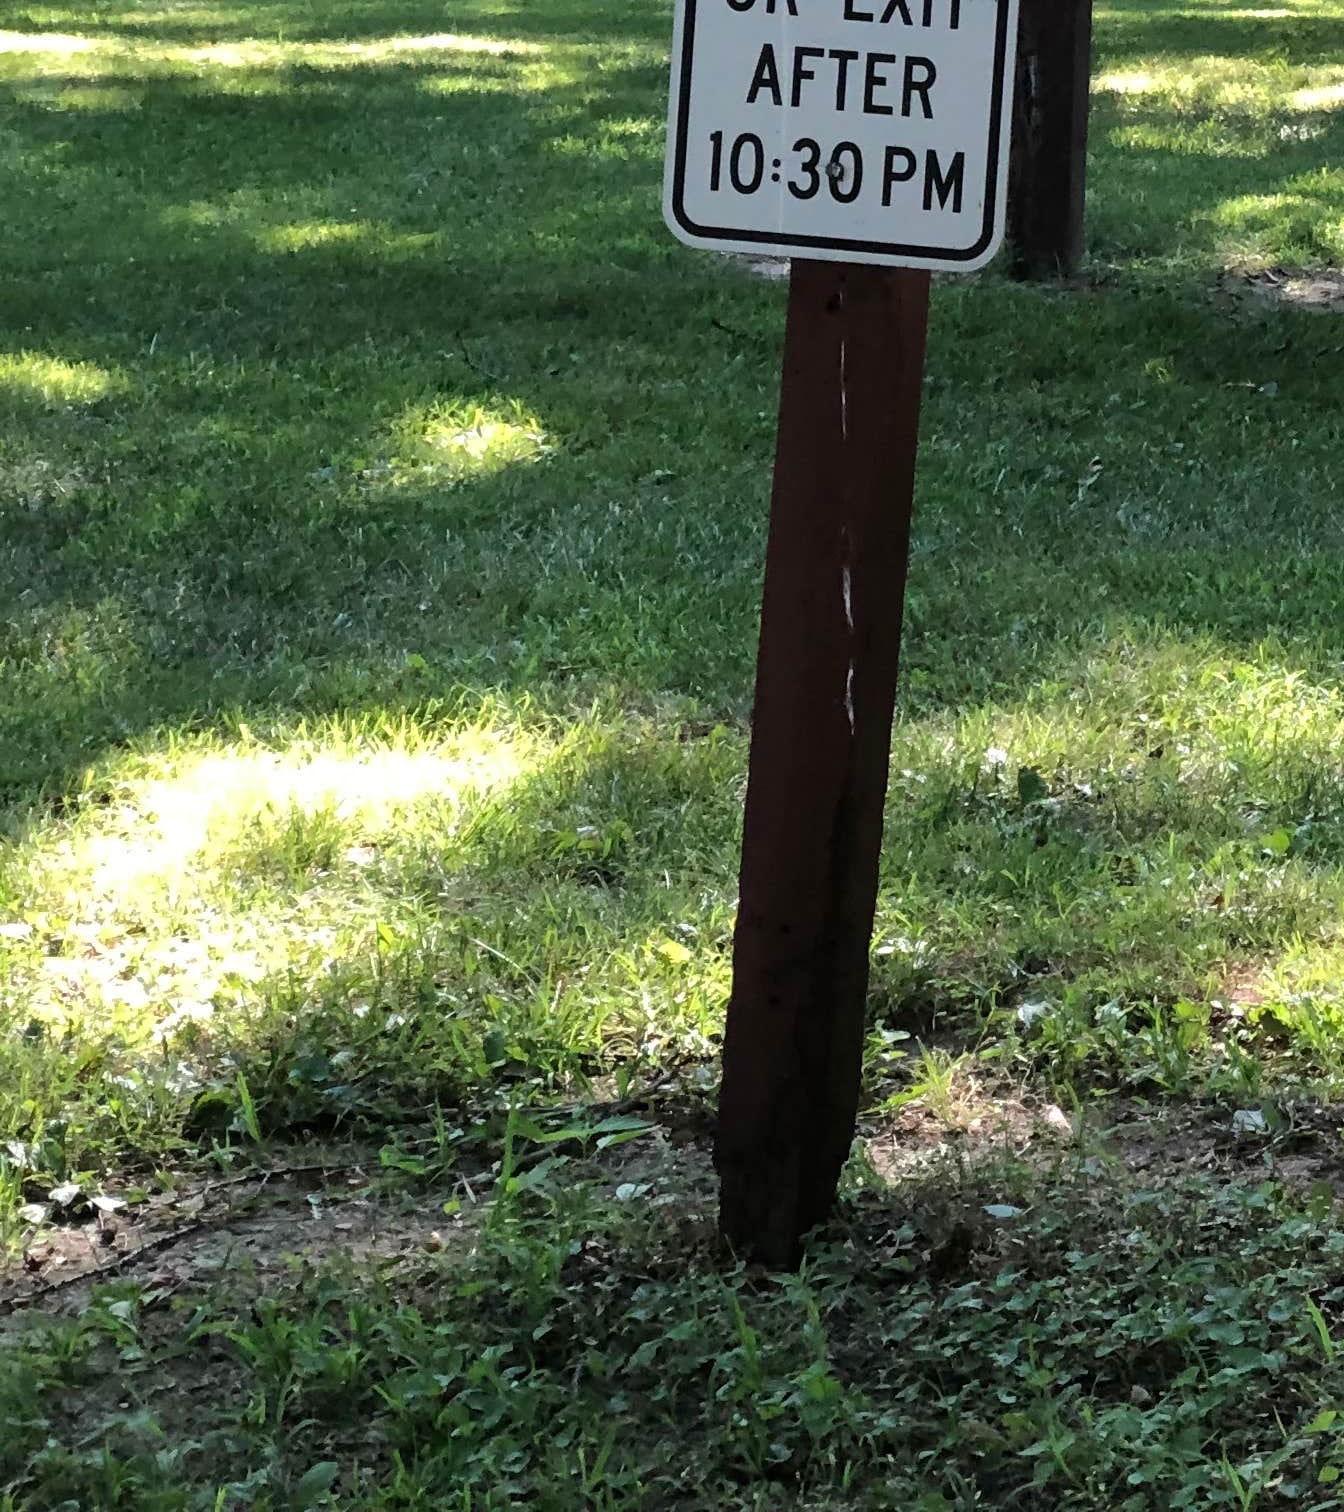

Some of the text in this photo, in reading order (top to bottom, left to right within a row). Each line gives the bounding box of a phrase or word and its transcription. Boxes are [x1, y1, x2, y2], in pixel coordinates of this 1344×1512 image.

[746, 43, 938, 120] AFTER
[709, 129, 966, 214] 10:30 PM
